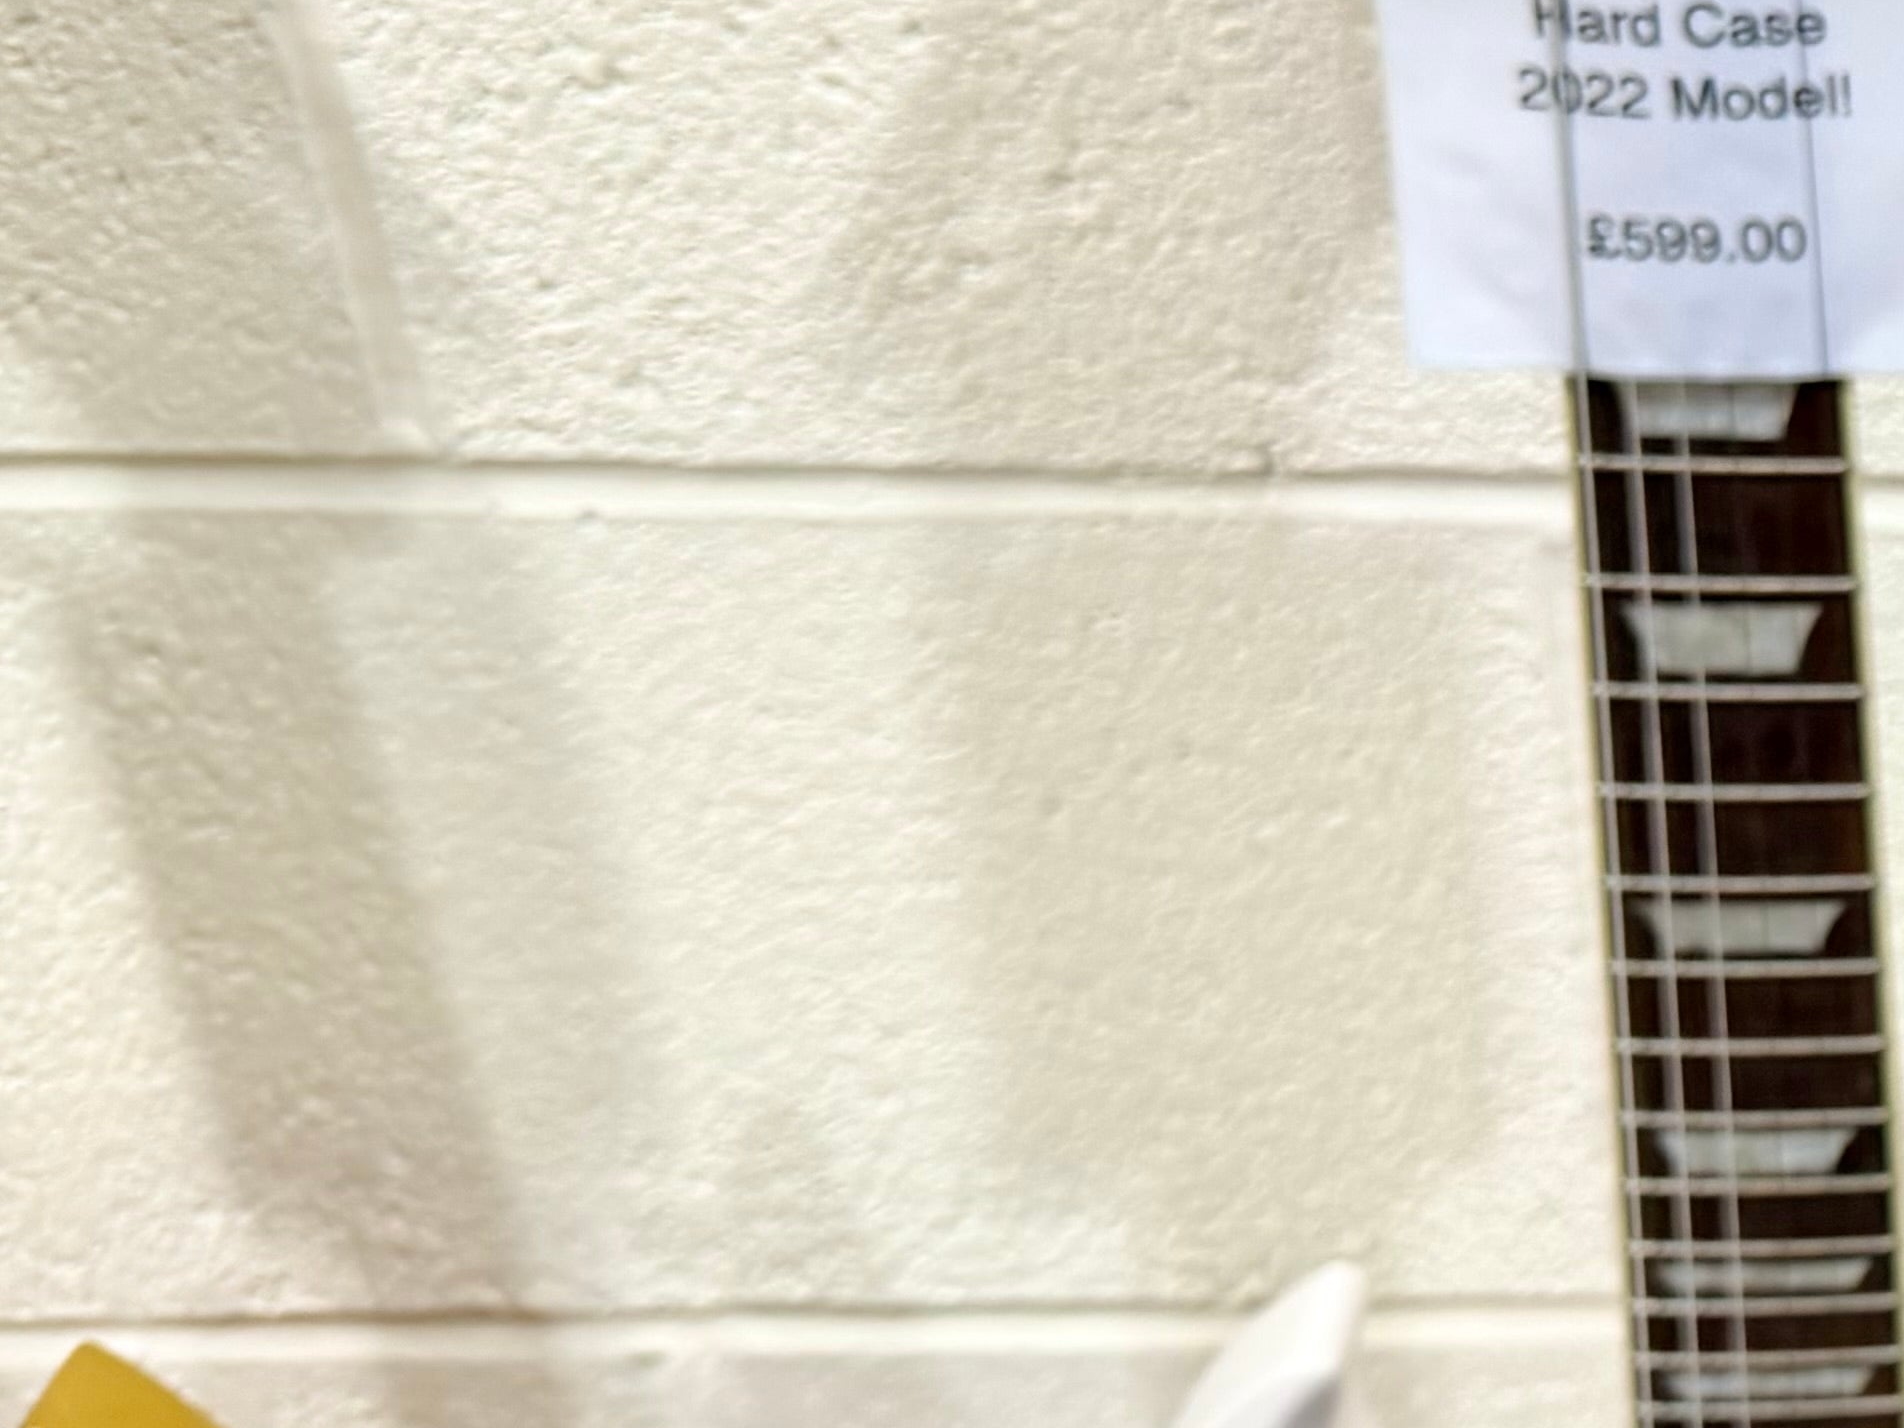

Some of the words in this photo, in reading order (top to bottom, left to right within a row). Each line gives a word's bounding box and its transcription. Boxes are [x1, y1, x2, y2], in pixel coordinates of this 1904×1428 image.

[1682, 0, 1828, 48] Case
[1517, 67, 1651, 119] 2022
[1585, 212, 1807, 264] £599.00
